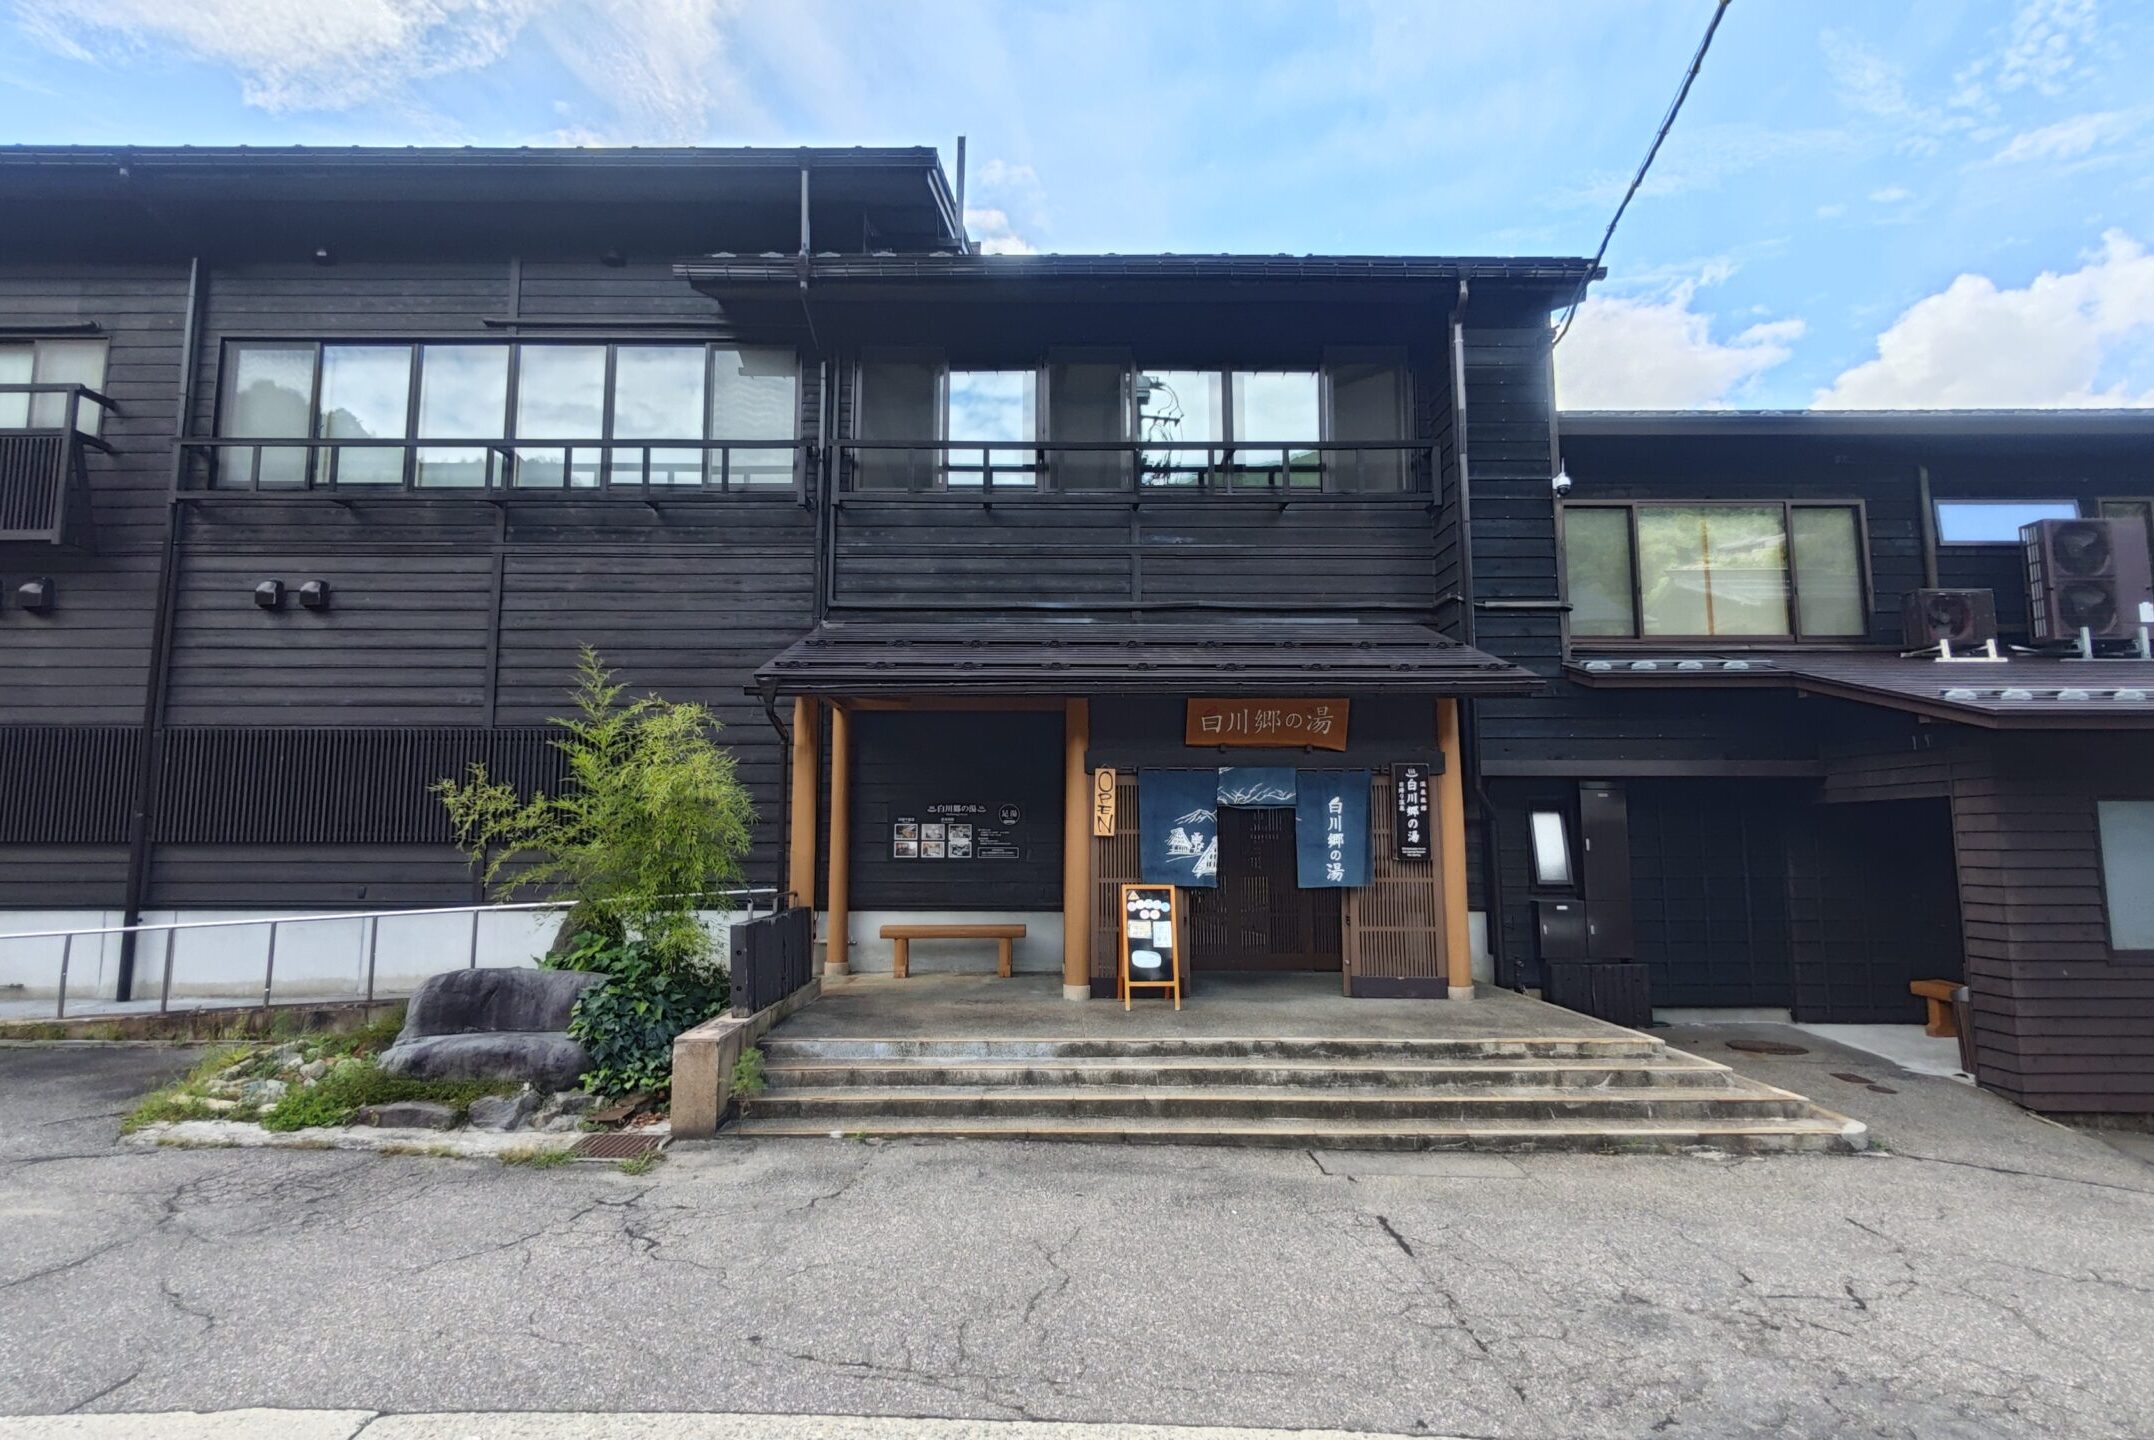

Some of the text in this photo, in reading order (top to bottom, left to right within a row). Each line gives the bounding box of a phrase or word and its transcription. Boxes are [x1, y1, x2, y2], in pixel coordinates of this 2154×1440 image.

[1201, 706, 1334, 735] 白川郷の湯
[1097, 771, 1114, 833] OPEN
[1406, 778, 1420, 843] 白川郷の湯
[1326, 796, 1345, 881] 白川郷の湯
